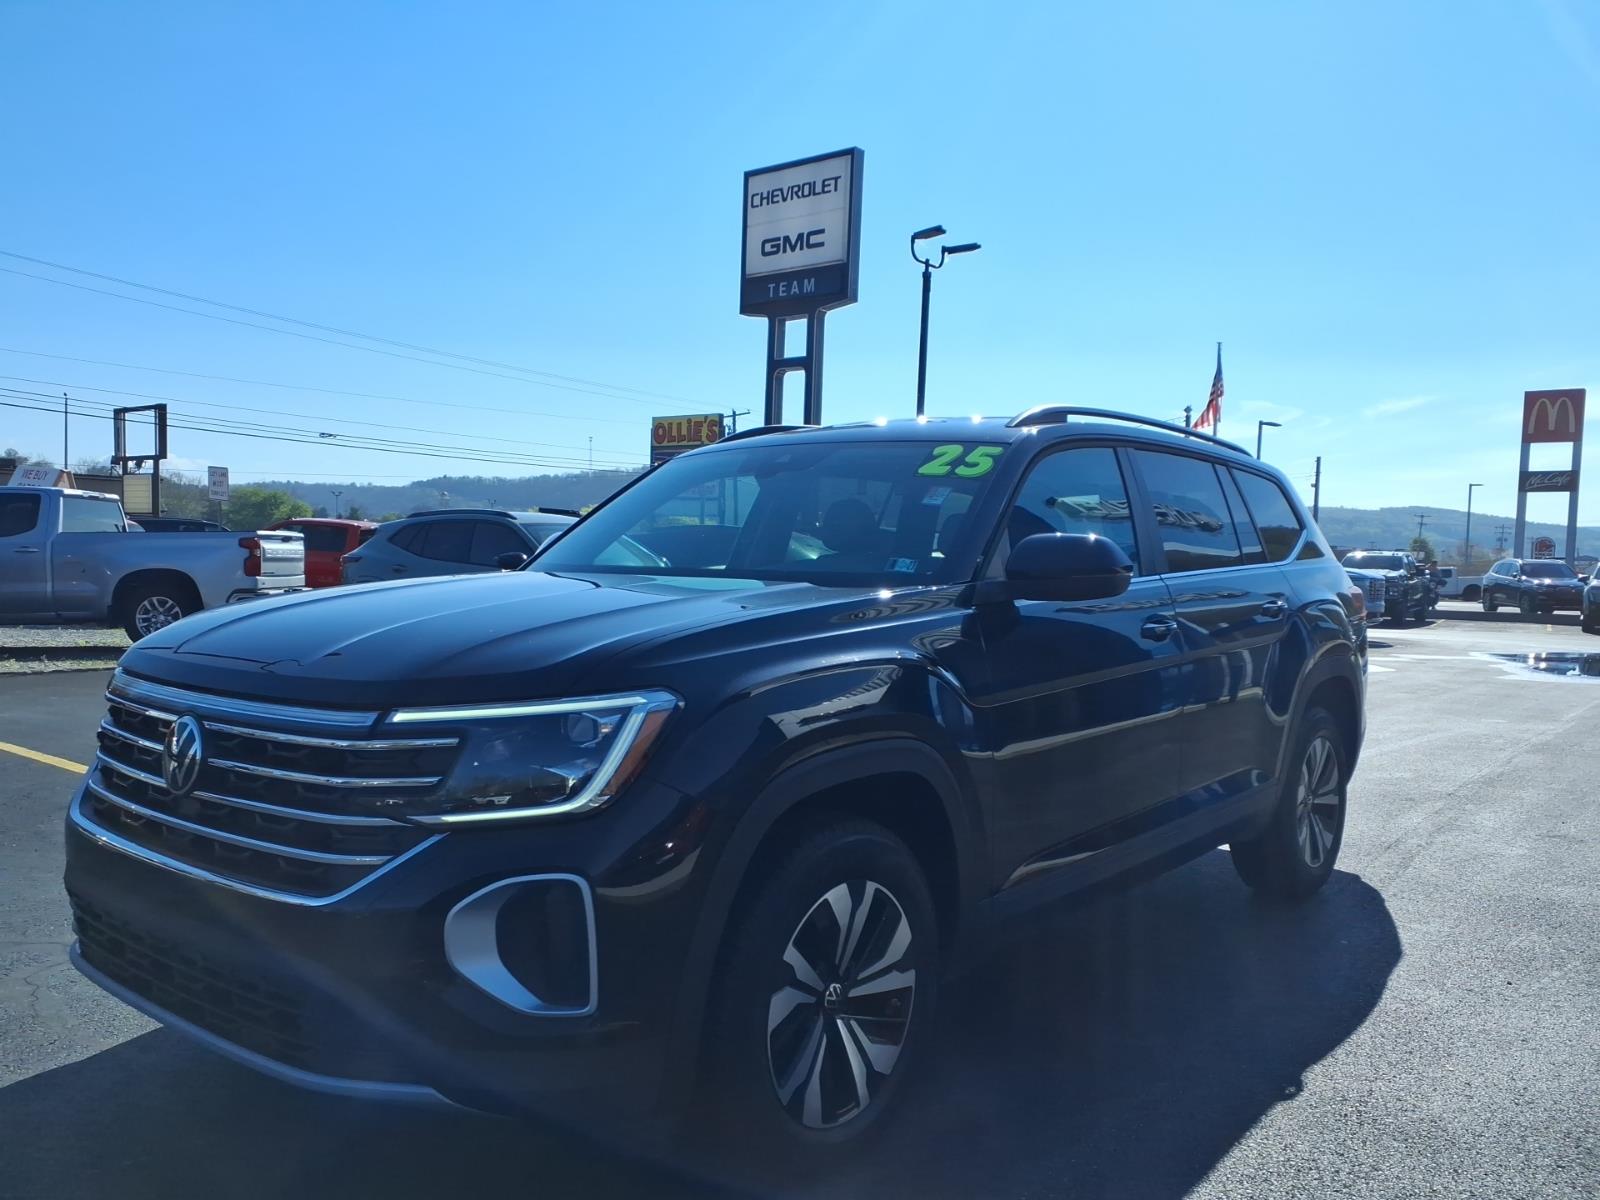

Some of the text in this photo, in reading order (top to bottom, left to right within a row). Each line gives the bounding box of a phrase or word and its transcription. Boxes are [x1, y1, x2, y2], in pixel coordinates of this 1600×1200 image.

[751, 176, 842, 209] CHEVROLET
[761, 228, 826, 257] GMC
[768, 278, 816, 298] TEAM
[915, 444, 1004, 478] 25
